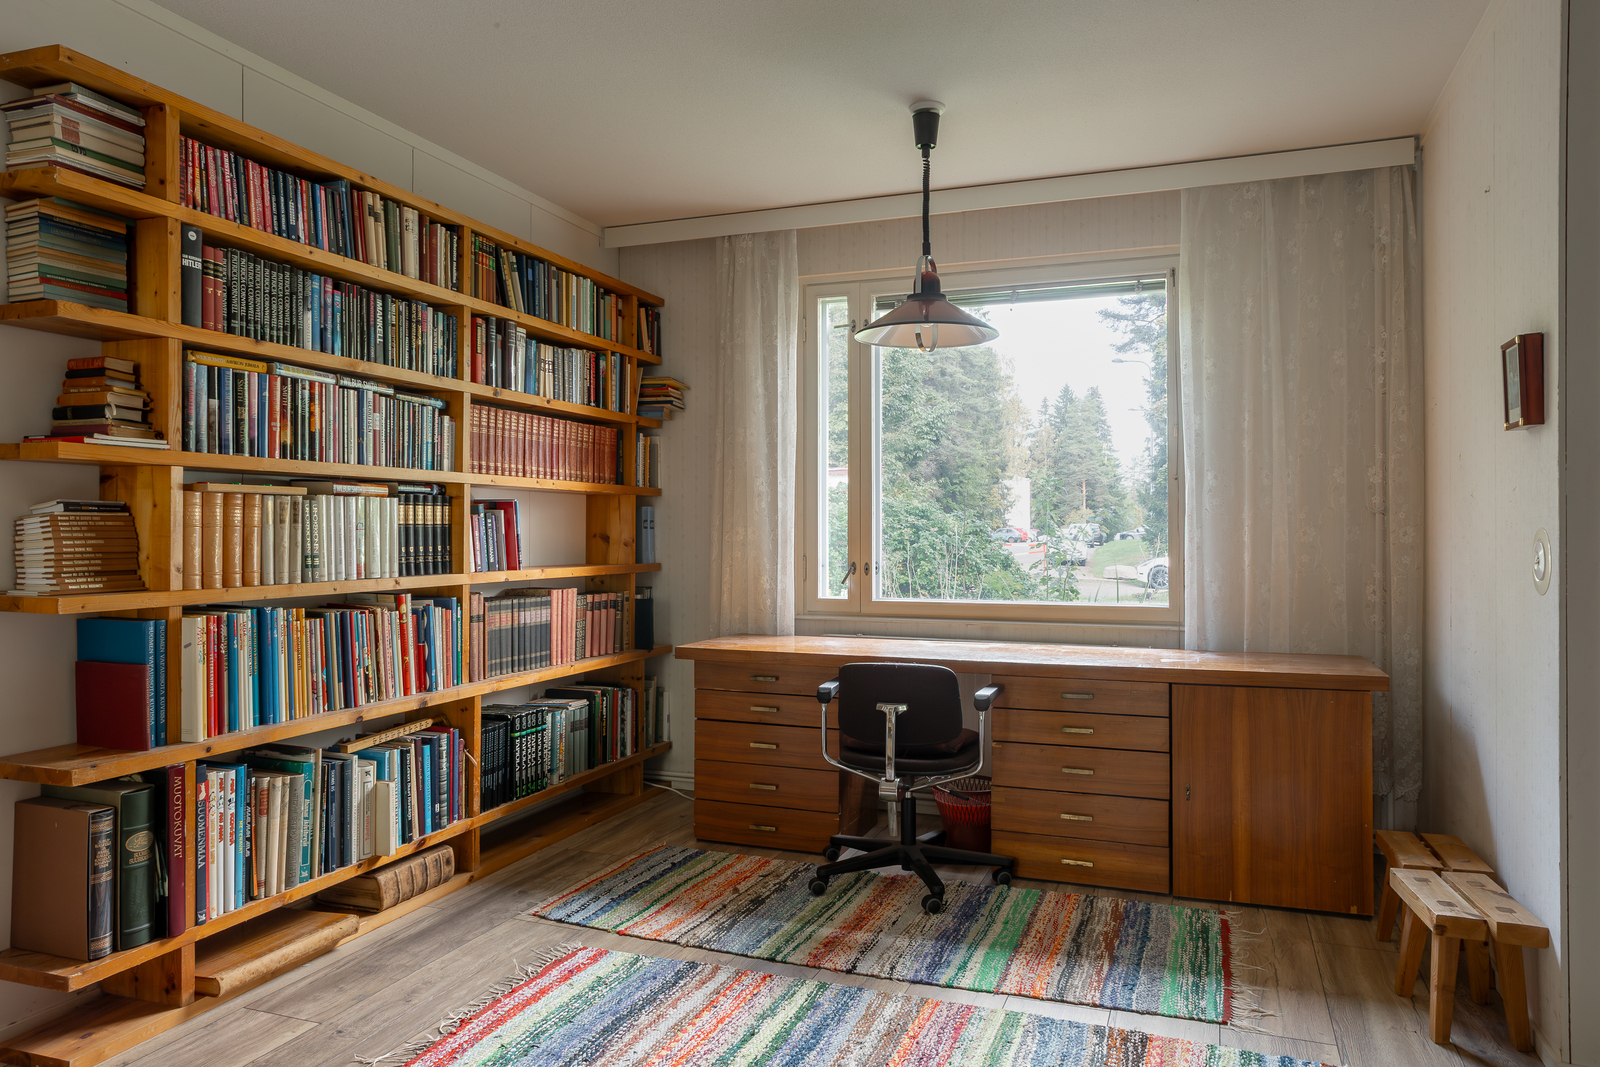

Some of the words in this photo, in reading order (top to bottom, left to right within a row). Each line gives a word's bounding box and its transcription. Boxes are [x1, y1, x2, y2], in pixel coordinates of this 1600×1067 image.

[182, 258, 202, 270] HITLER
[522, 785, 526, 795] 2
[174, 776, 182, 858] MUOTOKUVAT
[198, 801, 206, 868] SUOMENMAA
